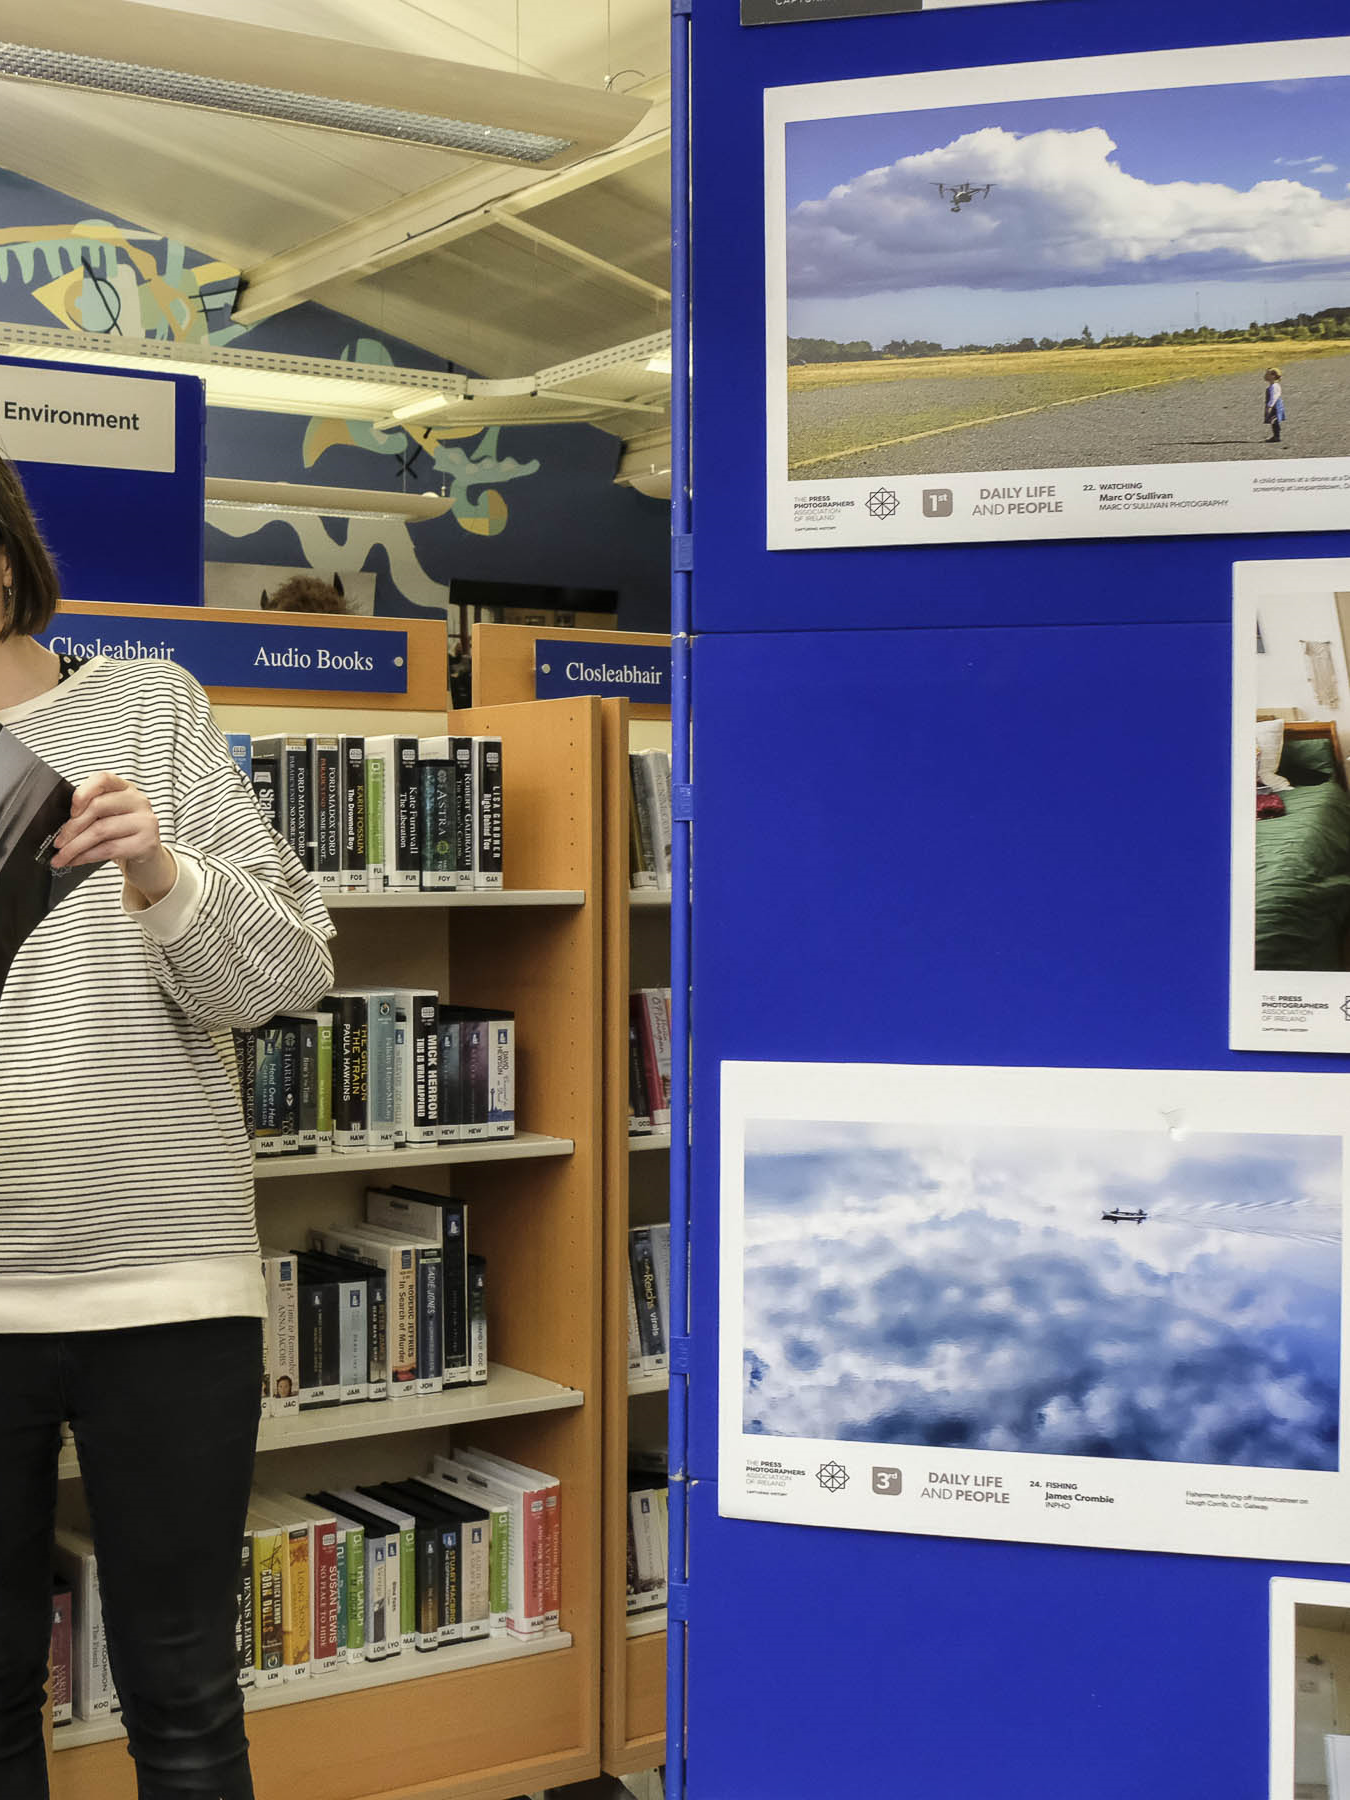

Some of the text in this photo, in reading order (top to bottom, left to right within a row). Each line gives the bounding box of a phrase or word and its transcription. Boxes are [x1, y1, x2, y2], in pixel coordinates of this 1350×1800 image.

[3, 401, 141, 431] Environment
[979, 486, 1056, 500] DAILY LIFE
[1099, 482, 1143, 490] WATCHING
[794, 501, 855, 509] PHOTOGRAPHERS
[1099, 492, 1174, 502] Marc O'Sullivan
[1169, 499, 1229, 508] PHOTOGRAPHY
[971, 502, 1064, 517] AND PEOPLE
[48, 636, 176, 661] Closleabhair
[254, 646, 374, 672] Audio Books
[565, 661, 663, 686] Closleabhair
[298, 794, 306, 831] MADOX
[437, 790, 447, 836] ASTRA
[482, 793, 491, 813] Right
[356, 785, 365, 855] KARIN FOSSUM
[409, 786, 418, 855] Kate Furnivall
[464, 773, 473, 866] ROBERT GALBRAITH
[483, 814, 491, 837] Behind
[492, 786, 501, 859] LISA GARDNER
[352, 1029, 360, 1054] THE
[246, 1034, 255, 1086] SUSANNA
[268, 1065, 277, 1085] Head
[283, 1053, 293, 1093] HARRIS
[342, 1057, 351, 1102] HAWKINS
[417, 1038, 426, 1119] THIS IS WHAT HAPPENED
[427, 1034, 438, 1121] MICK HERRON
[268, 1107, 277, 1128] Heel
[468, 1127, 482, 1135] HEW
[426, 1266, 436, 1315] SADIE JONES
[643, 1273, 657, 1310] Reichs
[278, 1304, 286, 1331] ANNA
[398, 1280, 407, 1364] In Search of Murder
[649, 1311, 659, 1337] virals
[311, 1390, 324, 1398] JAM
[346, 1388, 360, 1396] JAM
[420, 1381, 434, 1390] JON
[283, 1400, 296, 1408] JAC
[746, 1466, 806, 1475] PHOTOGRAPHERS
[876, 1472, 898, 1489] 3rd
[928, 1472, 1003, 1488] DAILY LIFE
[1045, 1482, 1078, 1490] FISHING
[920, 1489, 1010, 1504] AND PEOPLE
[1044, 1491, 1115, 1504] James Crombie
[1045, 1501, 1071, 1510] INPHO
[449, 1550, 457, 1583] STUART
[262, 1568, 273, 1633] CORN DOLLS
[329, 1565, 338, 1644] SUSAN LEWIS
[242, 1577, 254, 1666] DENNIS LEHANE
[321, 1610, 328, 1624] TO
[545, 1614, 557, 1622] MAN
[423, 1636, 437, 1644] MAC
[441, 1628, 455, 1636] MAC
[387, 1641, 400, 1649] LYO
[295, 1668, 306, 1676] LEV
[323, 1660, 337, 1668] LEW
[93, 1700, 108, 1710] KOO
